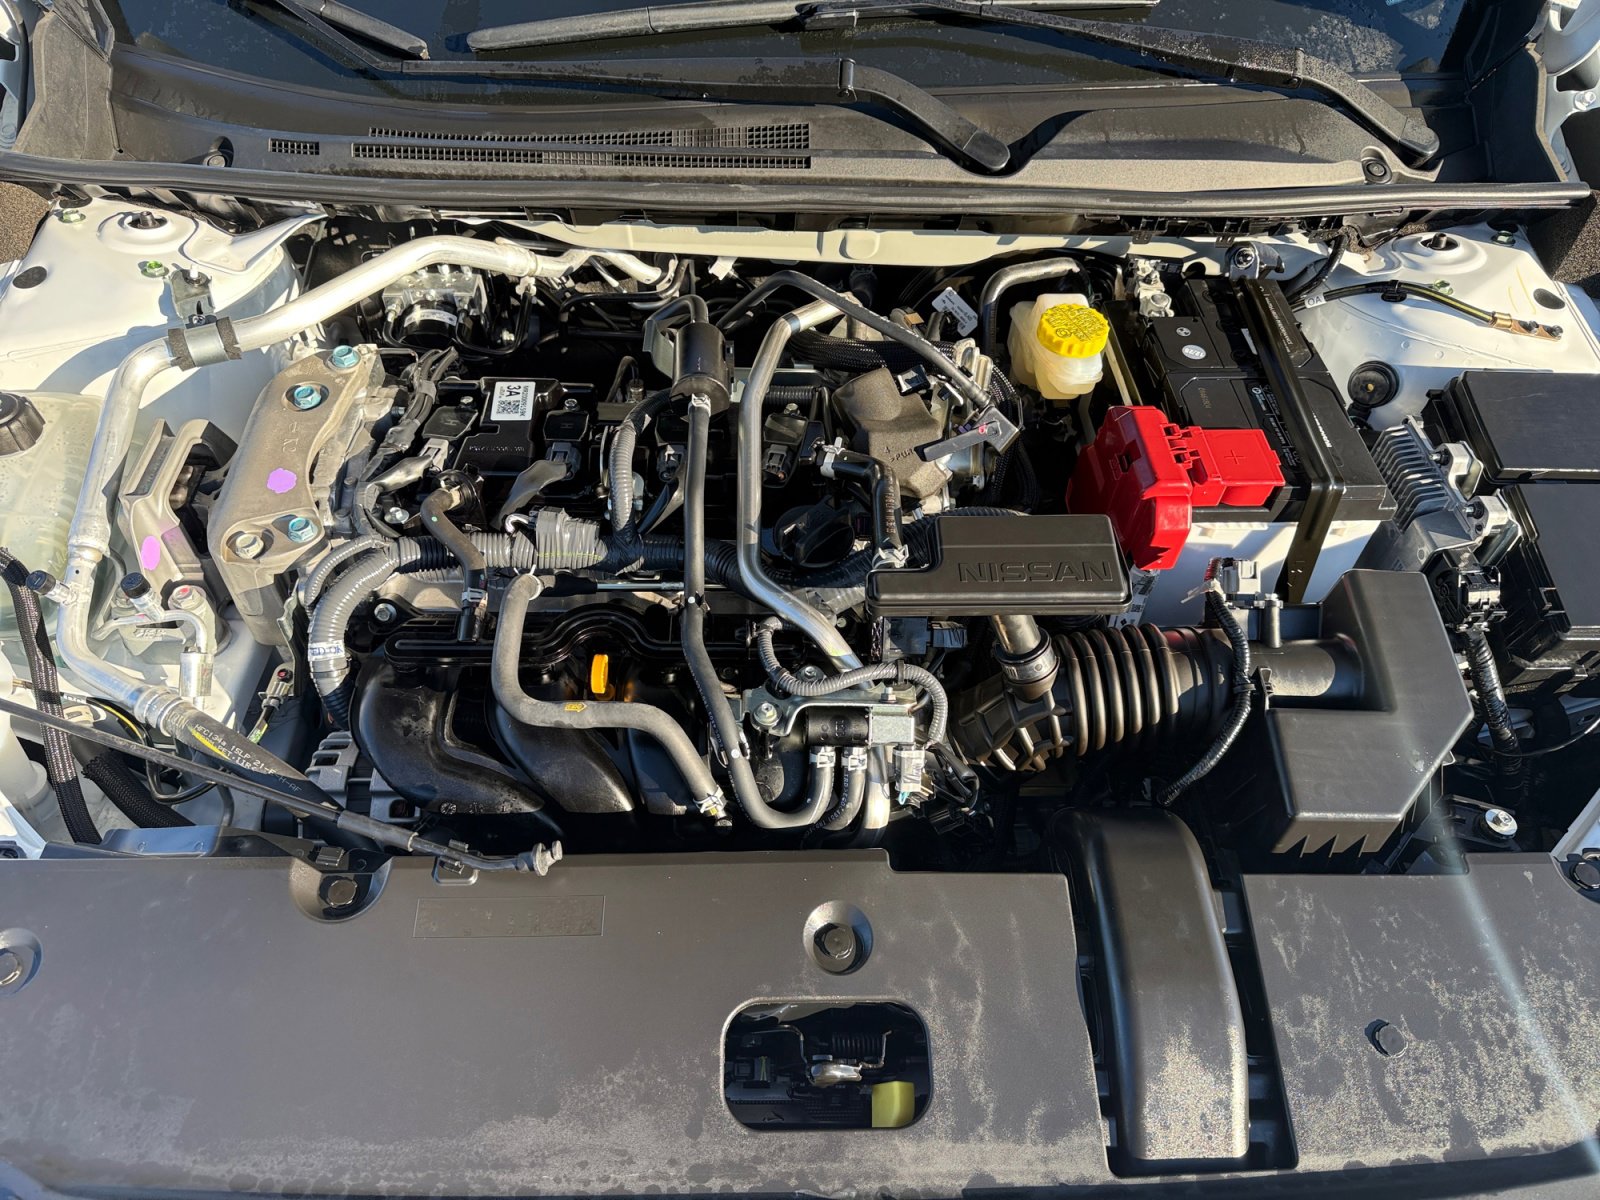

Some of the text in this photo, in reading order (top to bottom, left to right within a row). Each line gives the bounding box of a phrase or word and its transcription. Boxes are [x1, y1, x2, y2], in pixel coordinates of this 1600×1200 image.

[506, 385, 521, 397] 3A
[957, 561, 1114, 583] NISSAN
[194, 724, 227, 747] HFC134a
